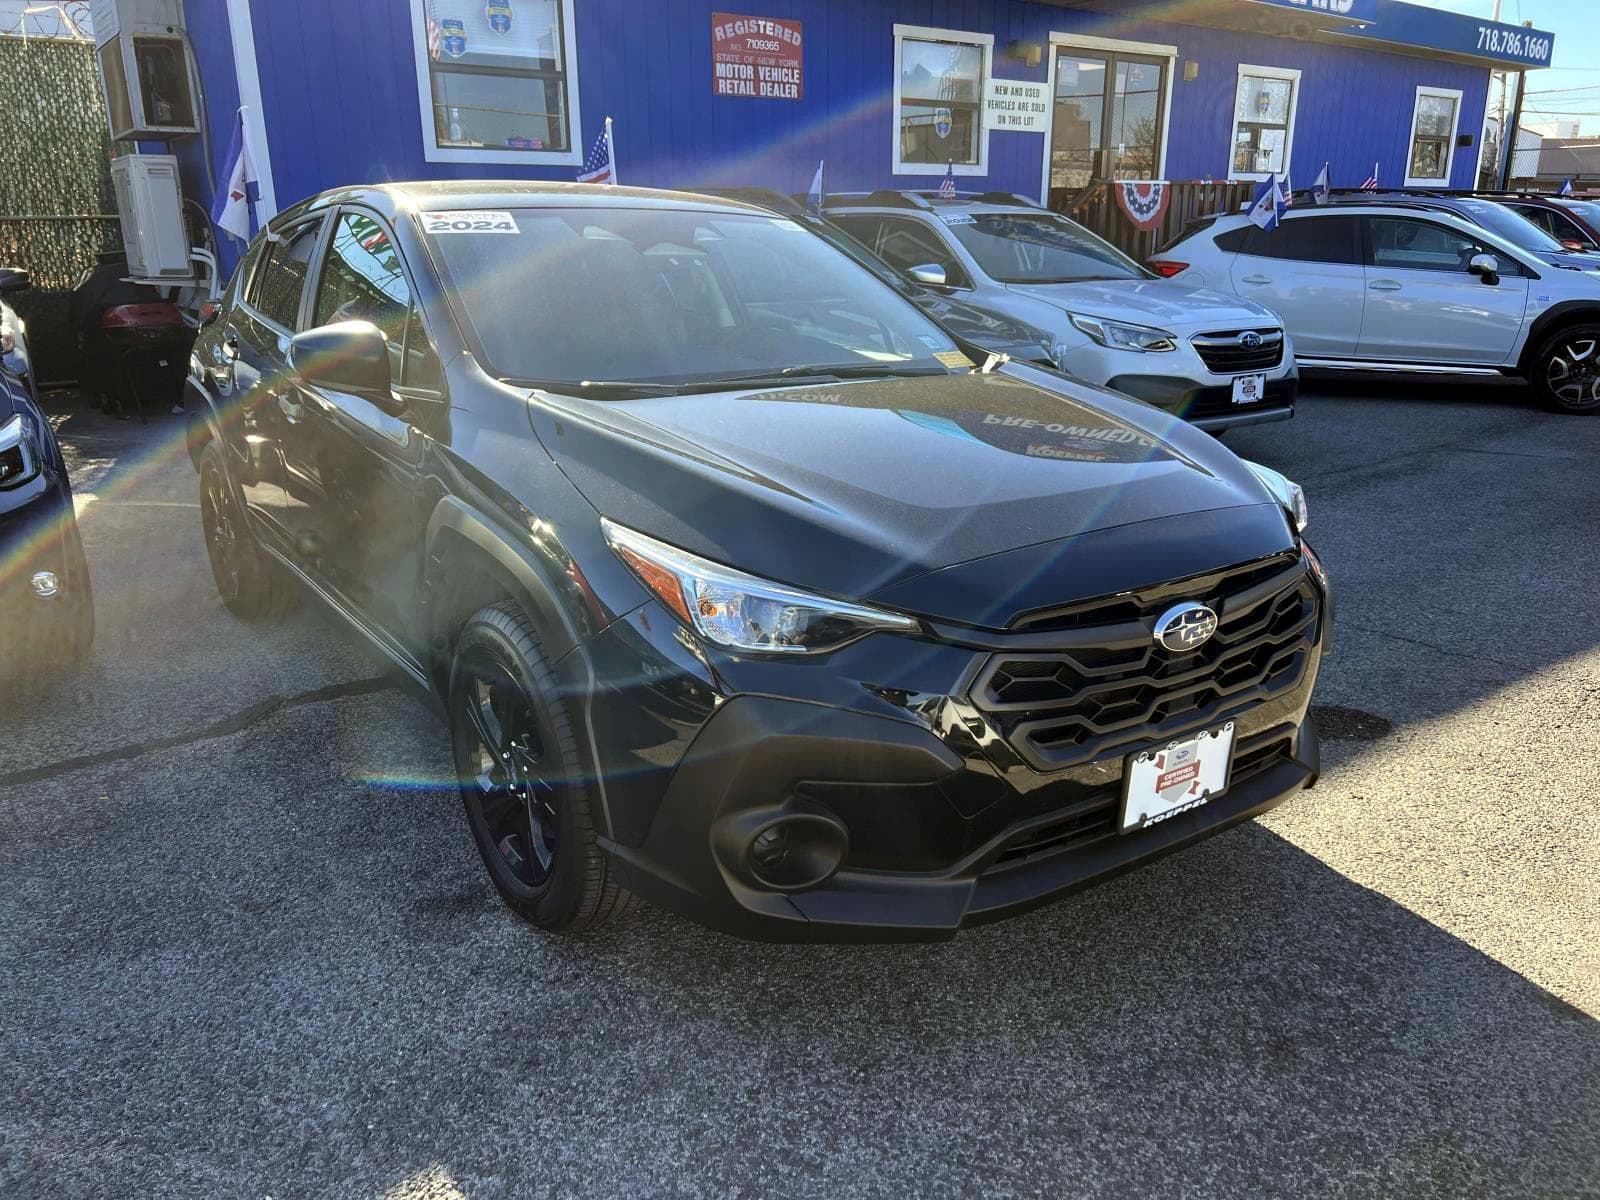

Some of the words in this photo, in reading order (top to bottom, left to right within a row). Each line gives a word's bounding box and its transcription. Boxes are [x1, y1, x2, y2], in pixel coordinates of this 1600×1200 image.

[714, 20, 801, 46] REGISTERED
[746, 39, 780, 51] 7109365
[1477, 27, 1549, 60] 718.786.1660
[716, 53, 741, 63] STATE
[743, 55, 754, 64] OF
[757, 57, 776, 66] NEW
[779, 59, 799, 68] YORK
[716, 63, 754, 79] MOTOR
[758, 66, 800, 83] VEHICLE
[719, 79, 756, 95] RETAIL
[760, 82, 798, 98] DEALER
[995, 85, 1008, 95] NEW
[1010, 87, 1023, 97] AND
[1024, 88, 1040, 98] USED
[988, 99, 1016, 111] VEHICLES
[1018, 102, 1029, 112] ARE
[1031, 103, 1046, 113] SOLD
[998, 114, 1007, 125] ON
[1008, 116, 1022, 126] THIS
[1023, 117, 1034, 126] LOT
[429, 221, 513, 231] 2024
[1160, 771, 1195, 788] PRE-OWNED
[1164, 766, 1194, 781] CERTIFIED
[1143, 798, 1208, 828] KOEPPEL
